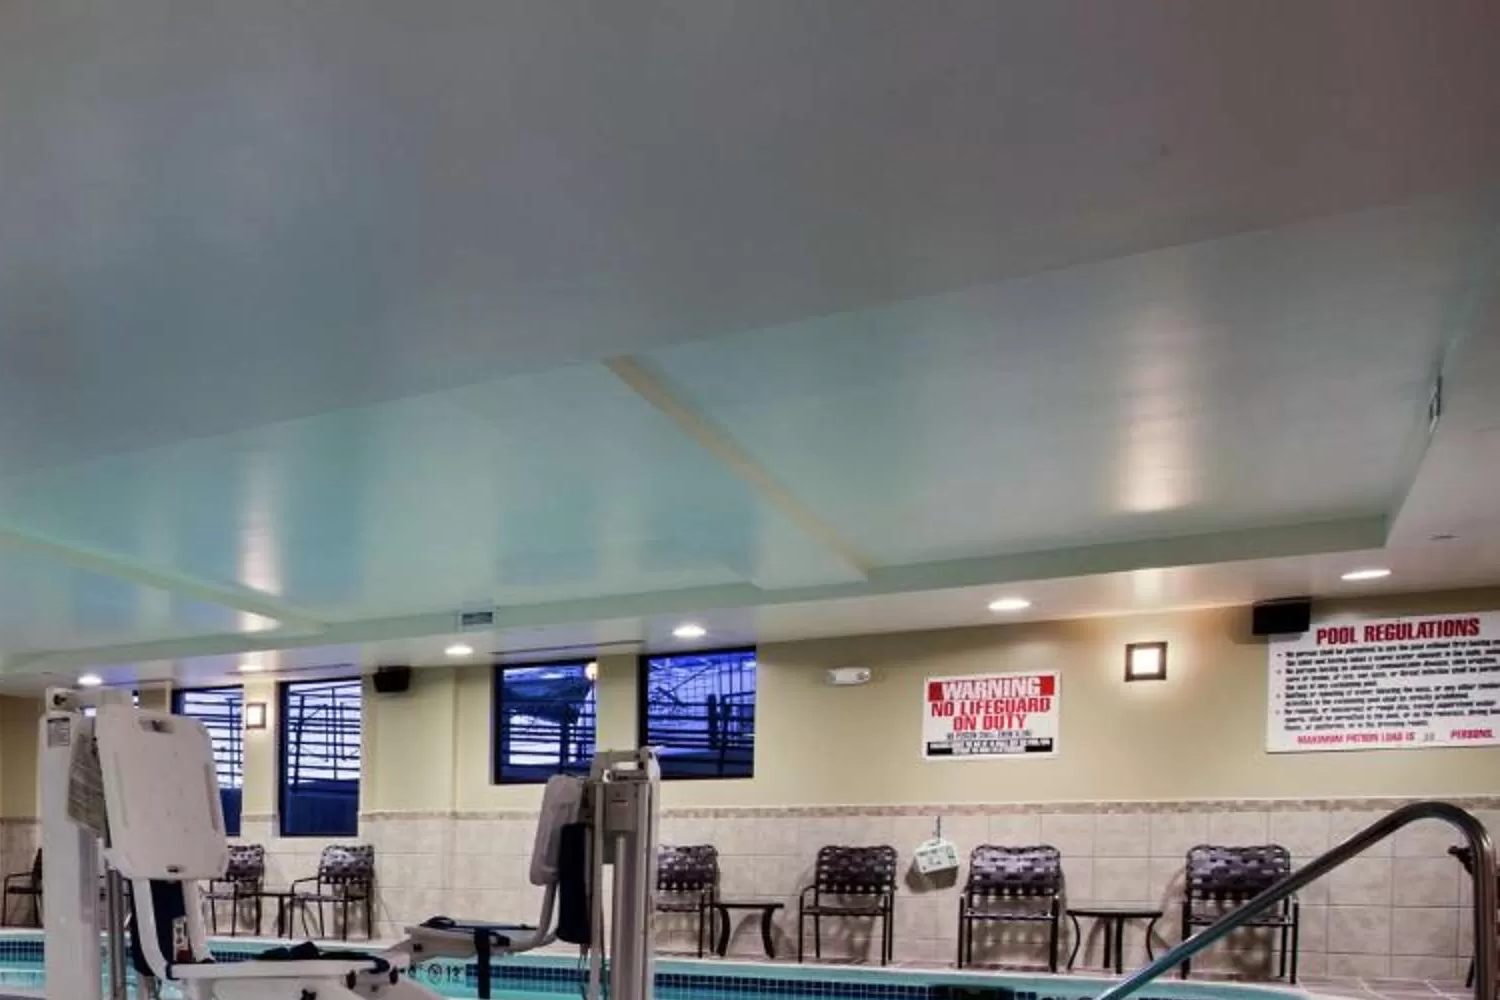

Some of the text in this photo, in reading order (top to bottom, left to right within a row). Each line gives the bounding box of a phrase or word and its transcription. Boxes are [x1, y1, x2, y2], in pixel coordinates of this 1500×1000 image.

[1316, 617, 1480, 645] POOL REGULATIONS
[942, 676, 1041, 700] WARNING
[931, 697, 1051, 717] NO LIFEGUARD
[953, 714, 1026, 731] ON DUTY
